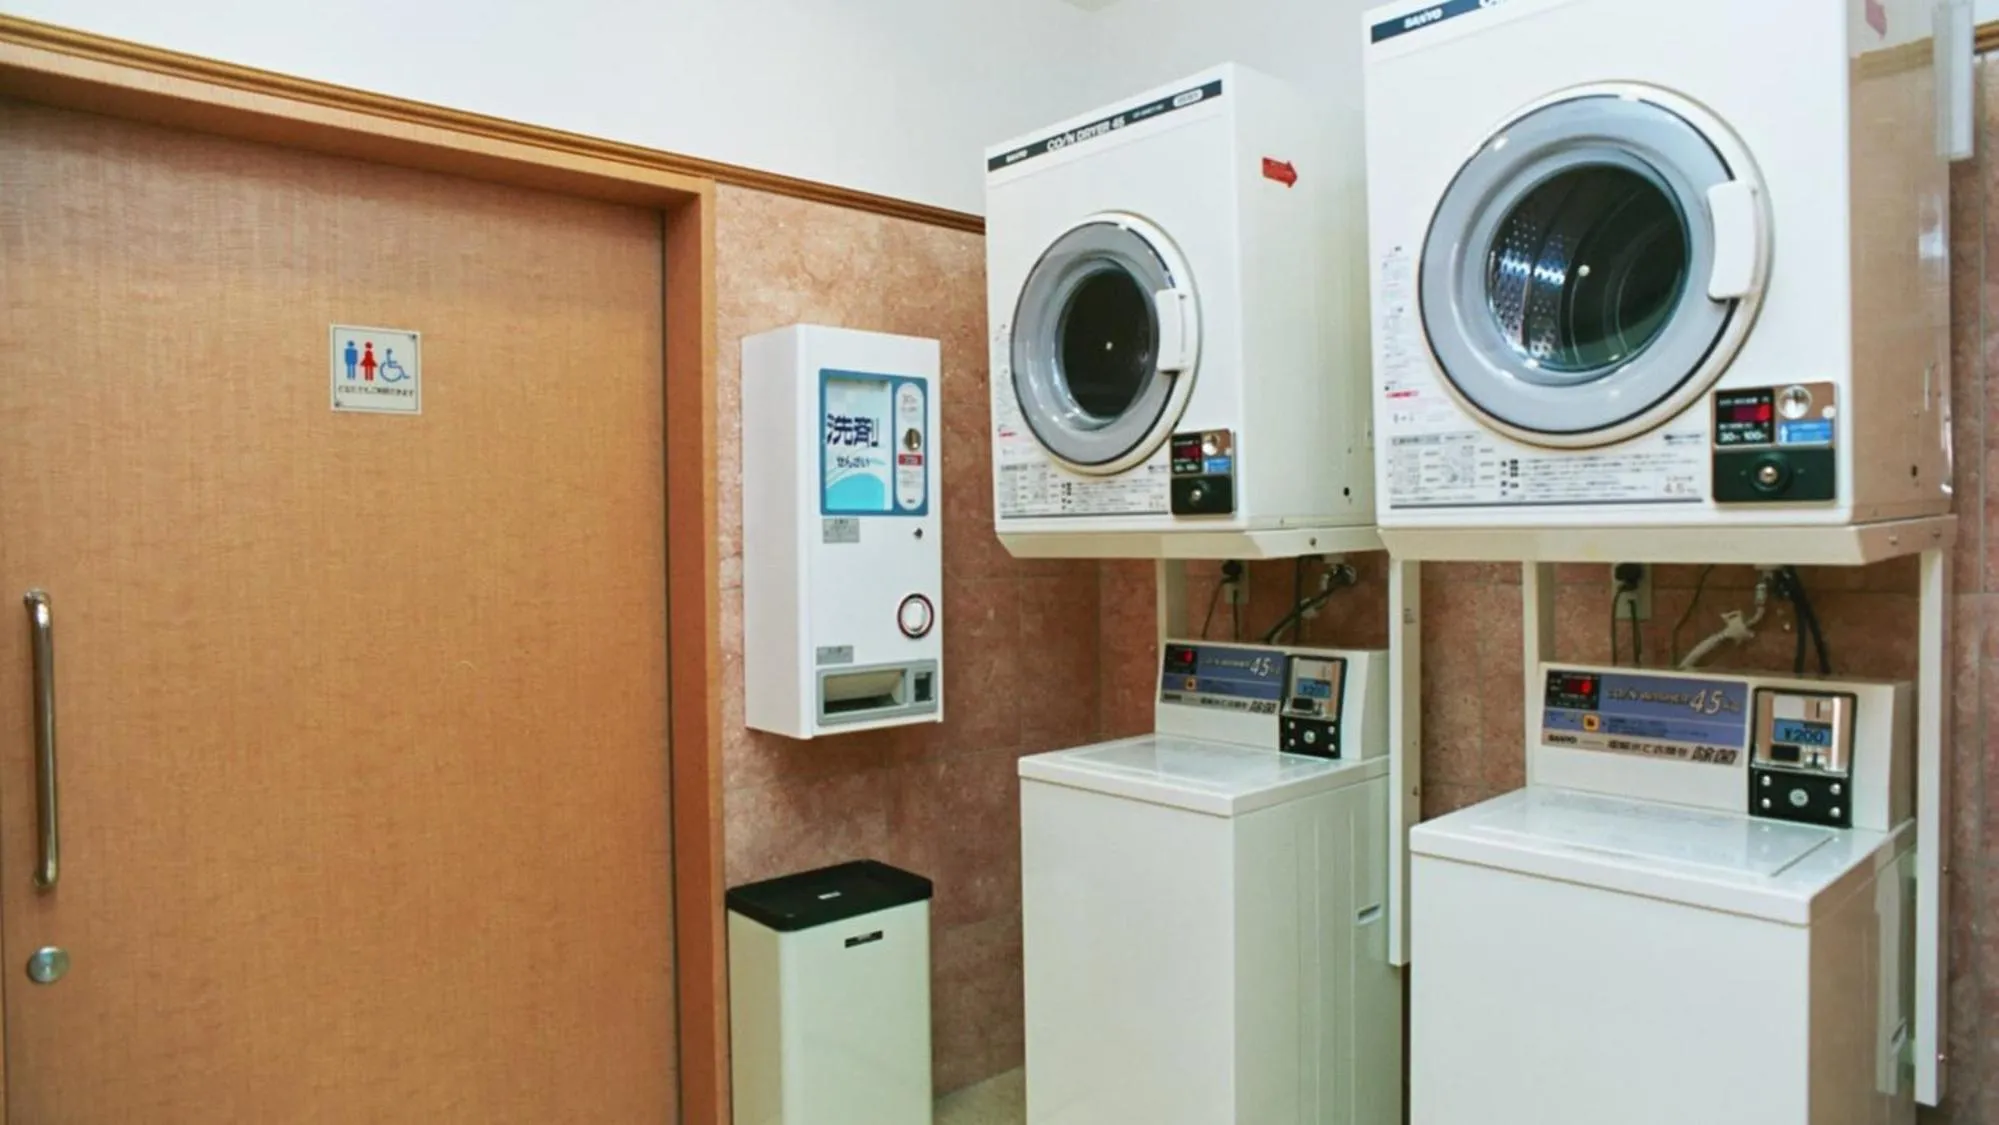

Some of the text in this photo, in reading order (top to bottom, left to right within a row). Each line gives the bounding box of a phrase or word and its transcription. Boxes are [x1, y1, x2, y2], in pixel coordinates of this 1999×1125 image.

[1403, 8, 1443, 29] SANYO
[827, 414, 879, 447] 洗剤
[1250, 657, 1271, 678] 45
[1689, 689, 1723, 715] 45
[1784, 727, 1825, 744] ¥200
